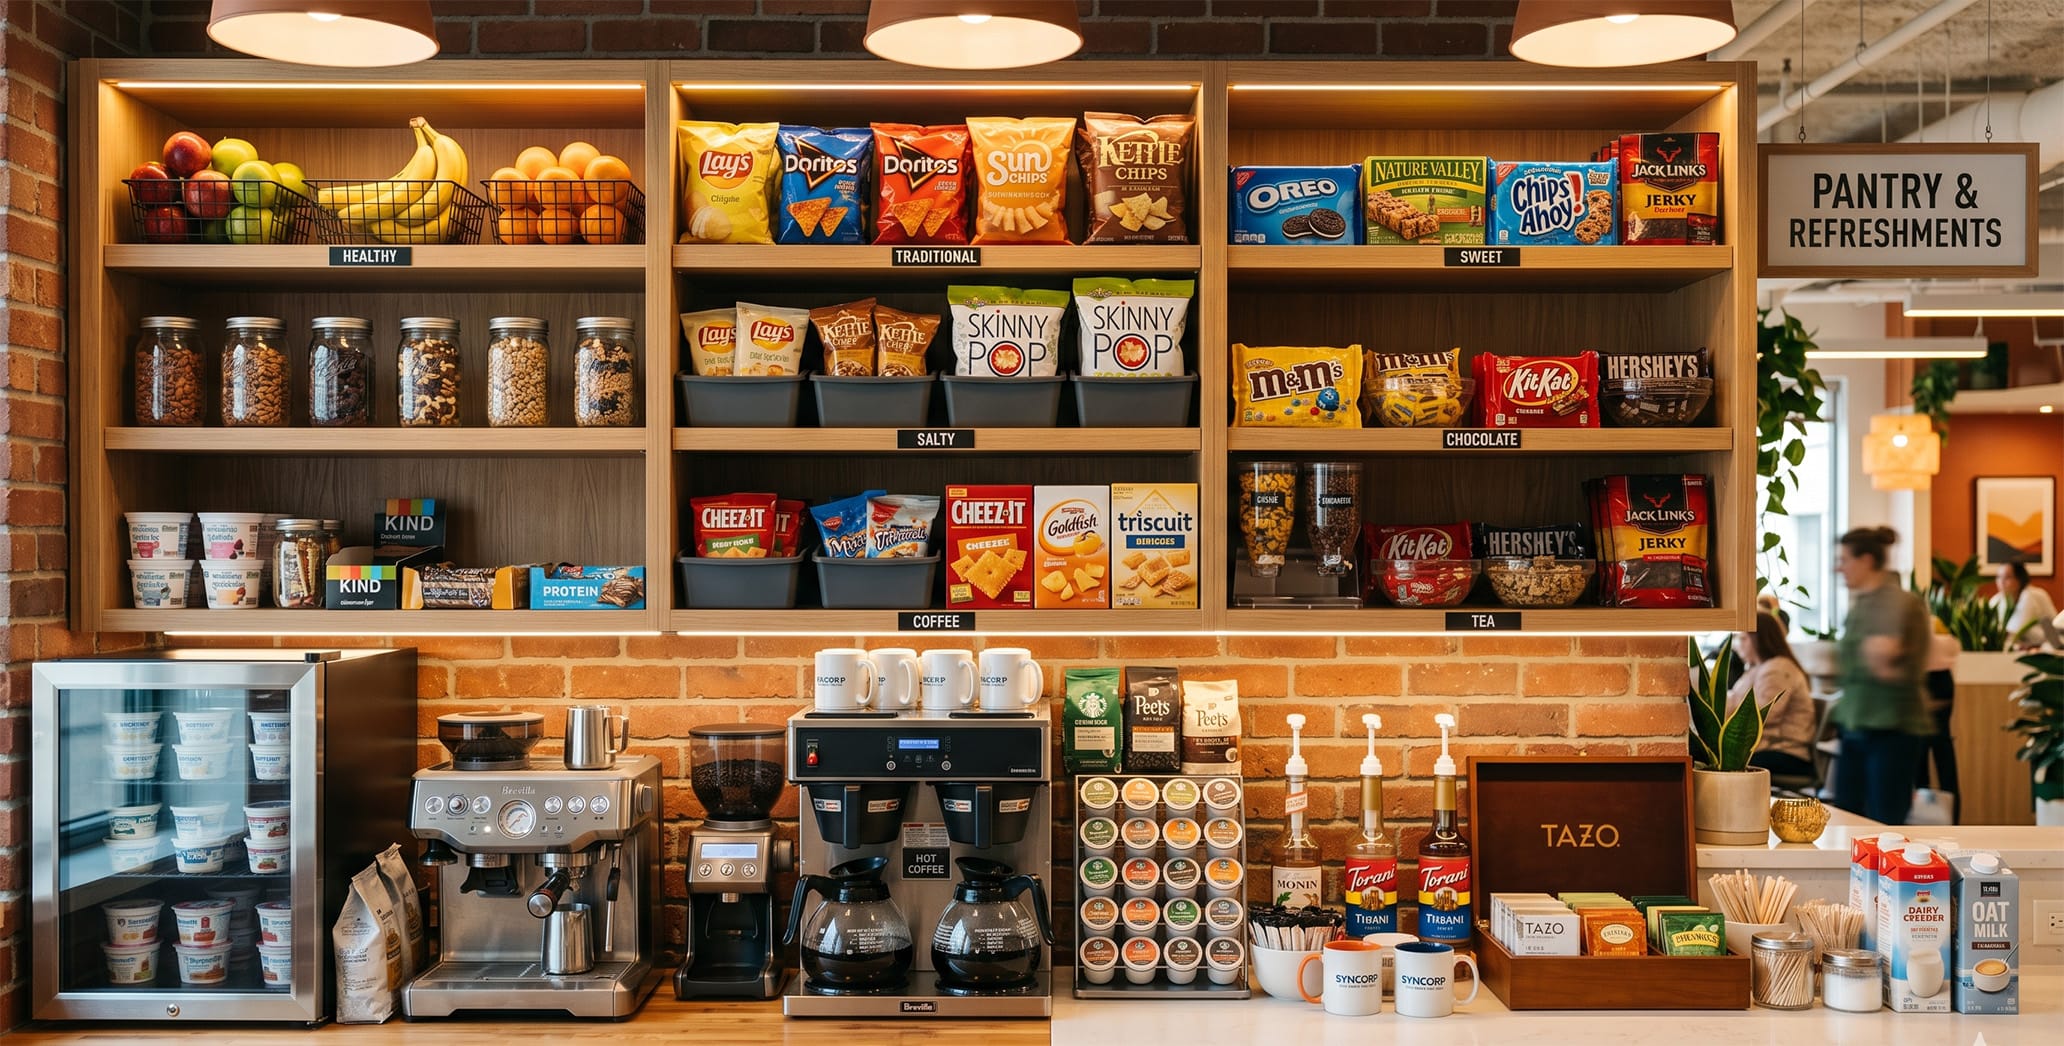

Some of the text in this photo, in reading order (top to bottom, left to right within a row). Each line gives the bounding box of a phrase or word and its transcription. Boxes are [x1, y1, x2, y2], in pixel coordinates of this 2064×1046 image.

[785, 154, 857, 174] Doritos
[884, 154, 958, 175] Doritos
[986, 148, 1052, 186] Sun
[1631, 165, 1666, 177] JACK
[1009, 172, 1048, 184] CHIPS
[1115, 167, 1168, 180] CHIPS
[1374, 161, 1481, 183] NATURE VALLEY
[1249, 179, 1338, 209] OREO
[1511, 178, 1571, 209] Chips
[1813, 173, 1978, 209] PANTRY &
[1645, 194, 1696, 208] JERKY
[1789, 218, 2002, 247] REFRESHMENTS
[342, 248, 397, 263] HEALTHY
[895, 250, 977, 263] TRADITIONAL
[1460, 250, 1503, 264] SWEET
[1093, 303, 1174, 331] SKINNY
[968, 311, 1049, 339] SKINNY
[968, 341, 1047, 377] POP
[1094, 333, 1173, 371] POP
[1607, 355, 1698, 379] HERSHEY'S
[1249, 361, 1344, 399] m&m's
[917, 433, 955, 446] SALTY
[1446, 433, 1518, 446] CHOCOLATE
[384, 516, 434, 531] KIND
[1118, 510, 1193, 532] triscuit
[1625, 510, 1656, 522] JACK
[1048, 511, 1097, 538] Goldfish
[1489, 530, 1577, 557] HERSHEY'S
[1638, 537, 1687, 551] JERKY
[339, 579, 382, 593] KIND
[542, 585, 599, 597] PROTEIN
[912, 615, 960, 628] COFFEE
[1471, 615, 1496, 628] TEA
[915, 854, 937, 863] HOT
[908, 864, 945, 875] COFFEE
[1277, 879, 1318, 889] MONIN
[1348, 864, 1396, 893] Torani
[1420, 864, 1468, 892] Torani
[1908, 906, 1939, 915] DAIRY
[1972, 901, 2010, 922] OAT
[1974, 923, 2008, 938] MILK
[1335, 974, 1378, 984] SYNCORP
[1401, 975, 1446, 986] SYNCORP
